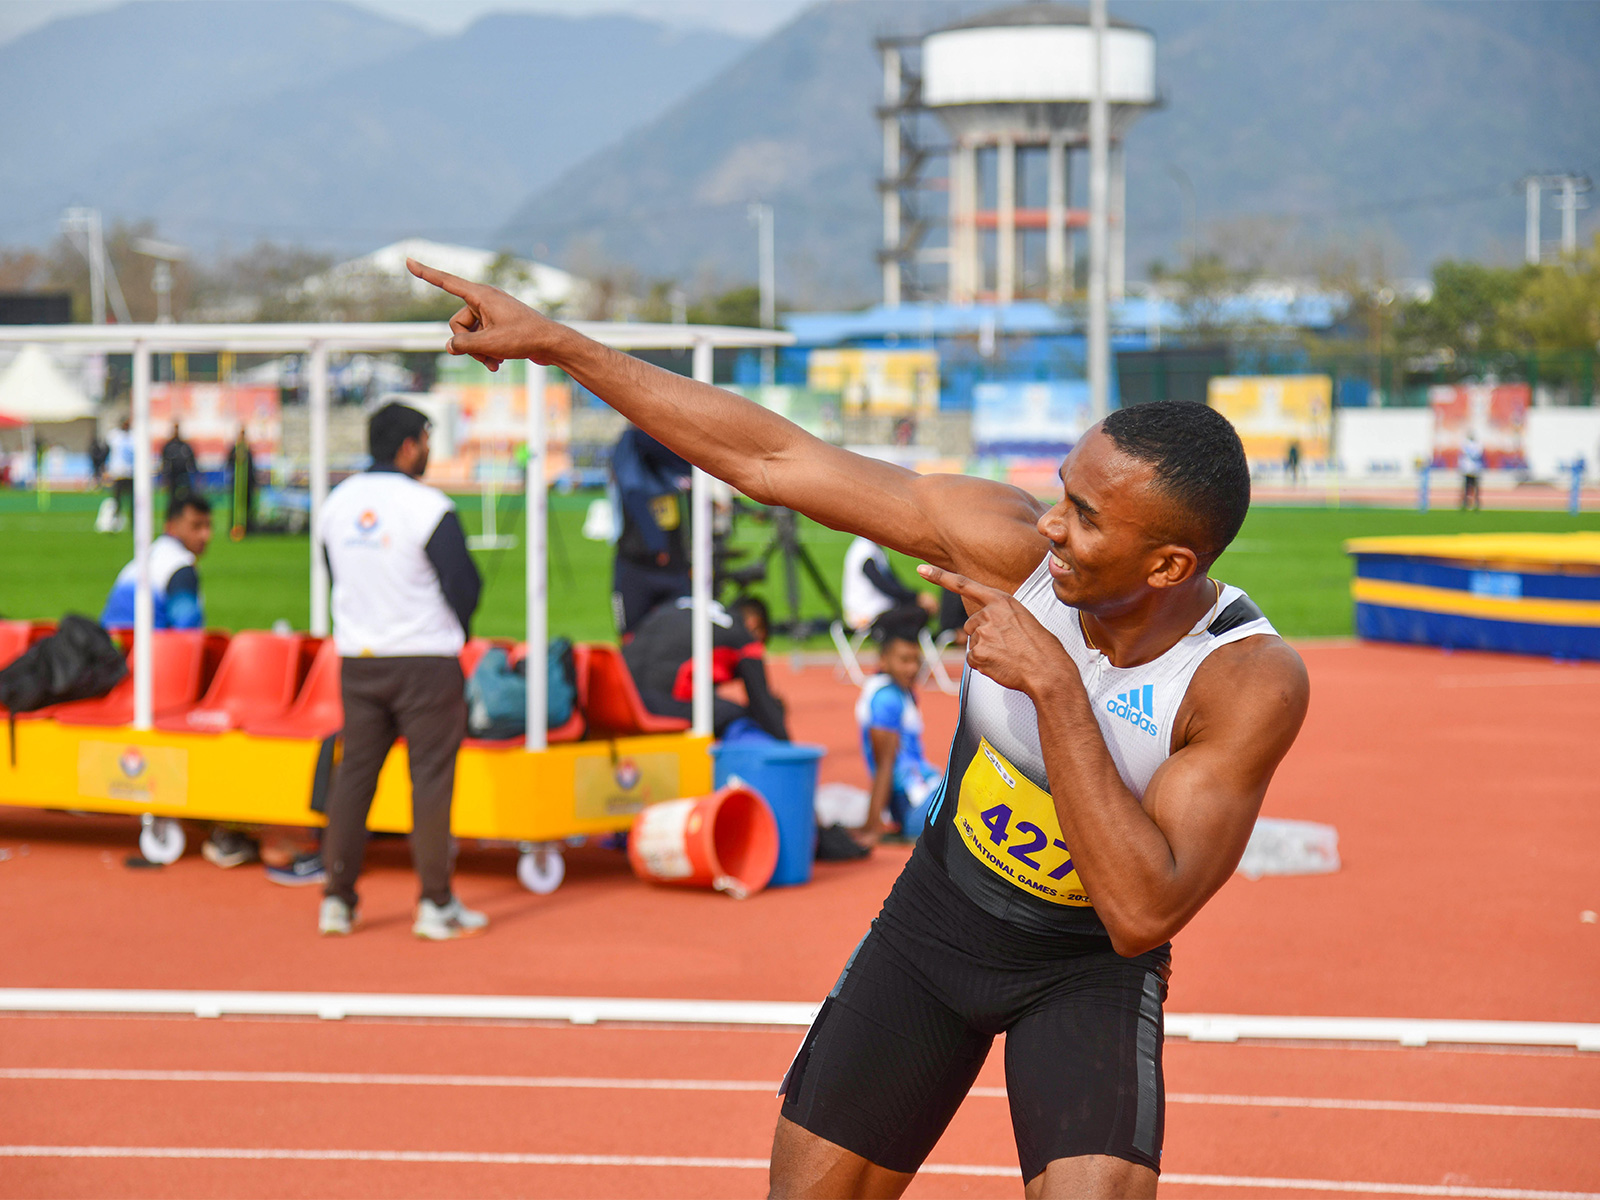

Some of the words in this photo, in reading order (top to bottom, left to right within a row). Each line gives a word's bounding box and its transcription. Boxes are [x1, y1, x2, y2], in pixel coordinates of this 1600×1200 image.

[1106, 699, 1158, 736] adidas
[972, 834, 1015, 878] NATIONAL
[1017, 874, 1058, 897] GAMES
[980, 803, 1074, 880] 427
